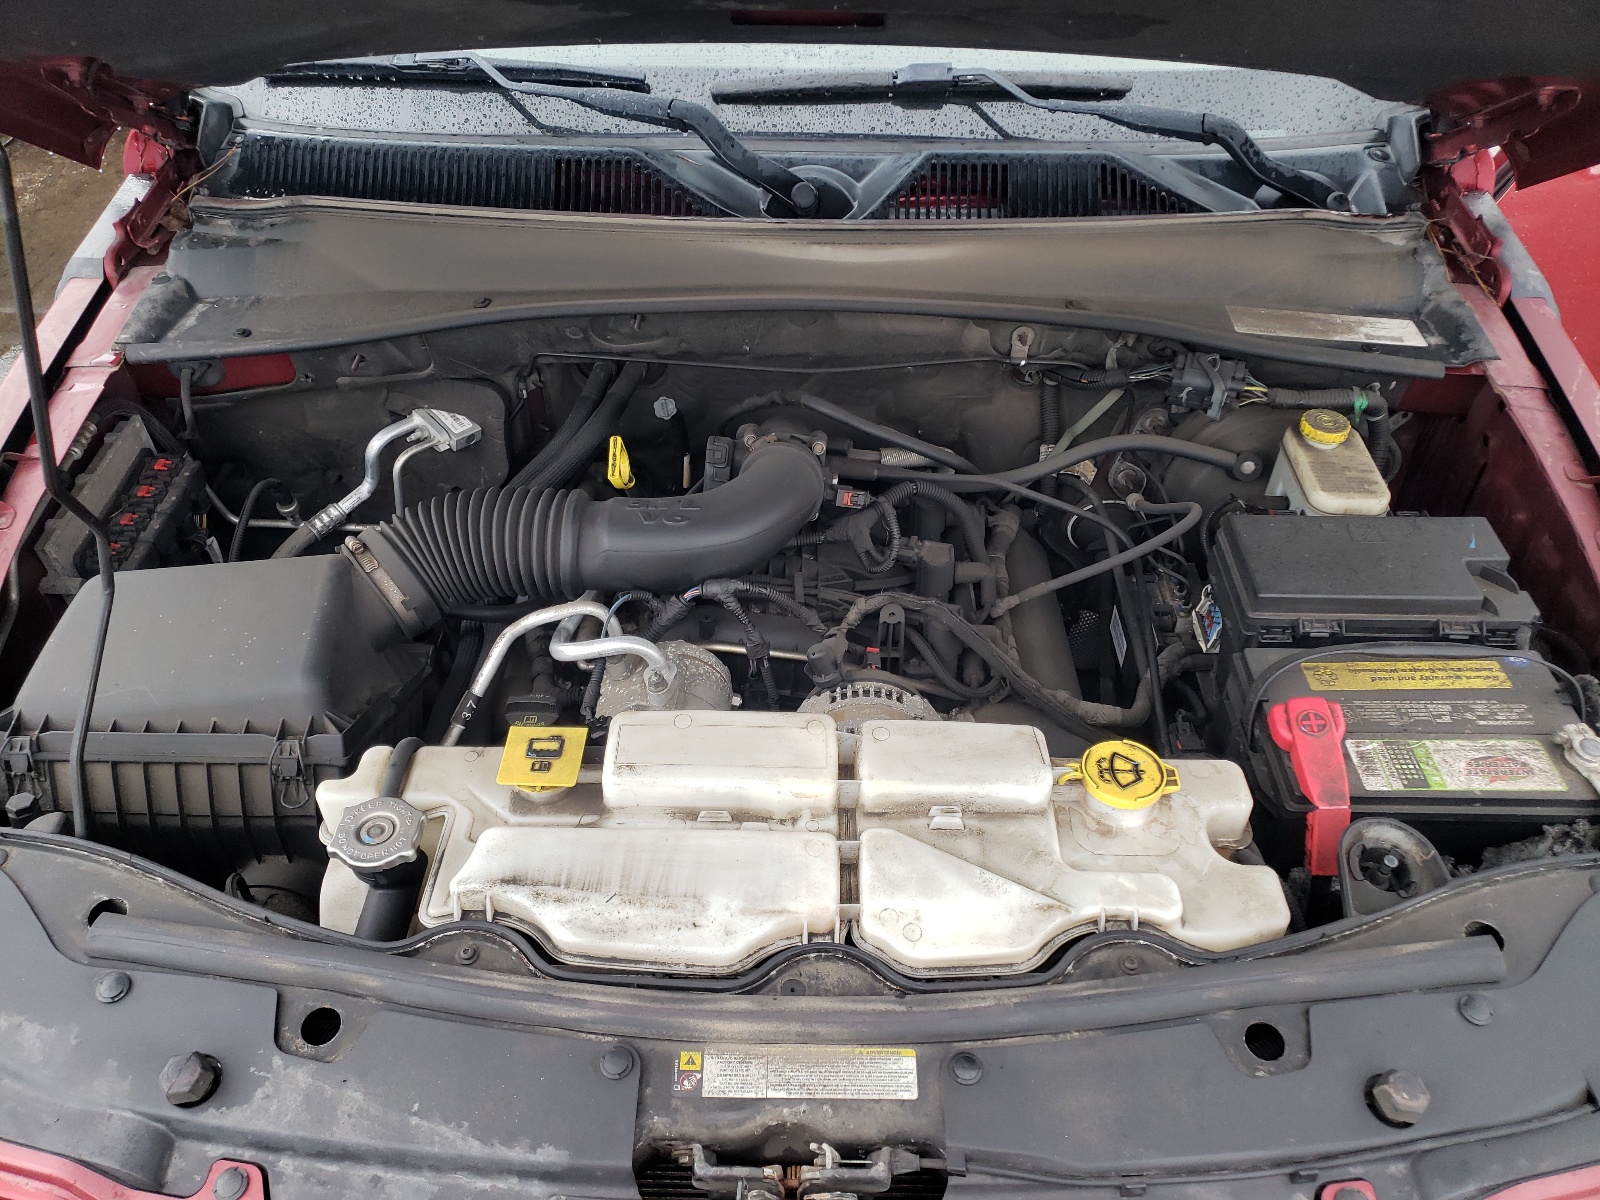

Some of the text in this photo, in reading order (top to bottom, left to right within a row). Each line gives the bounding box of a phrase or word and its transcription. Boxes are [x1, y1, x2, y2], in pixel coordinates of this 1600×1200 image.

[637, 510, 691, 526] V6
[461, 699, 477, 721] 3.7
[354, 801, 384, 816] KEEP
[342, 844, 361, 857] NOT
[360, 849, 389, 860] OPEN
